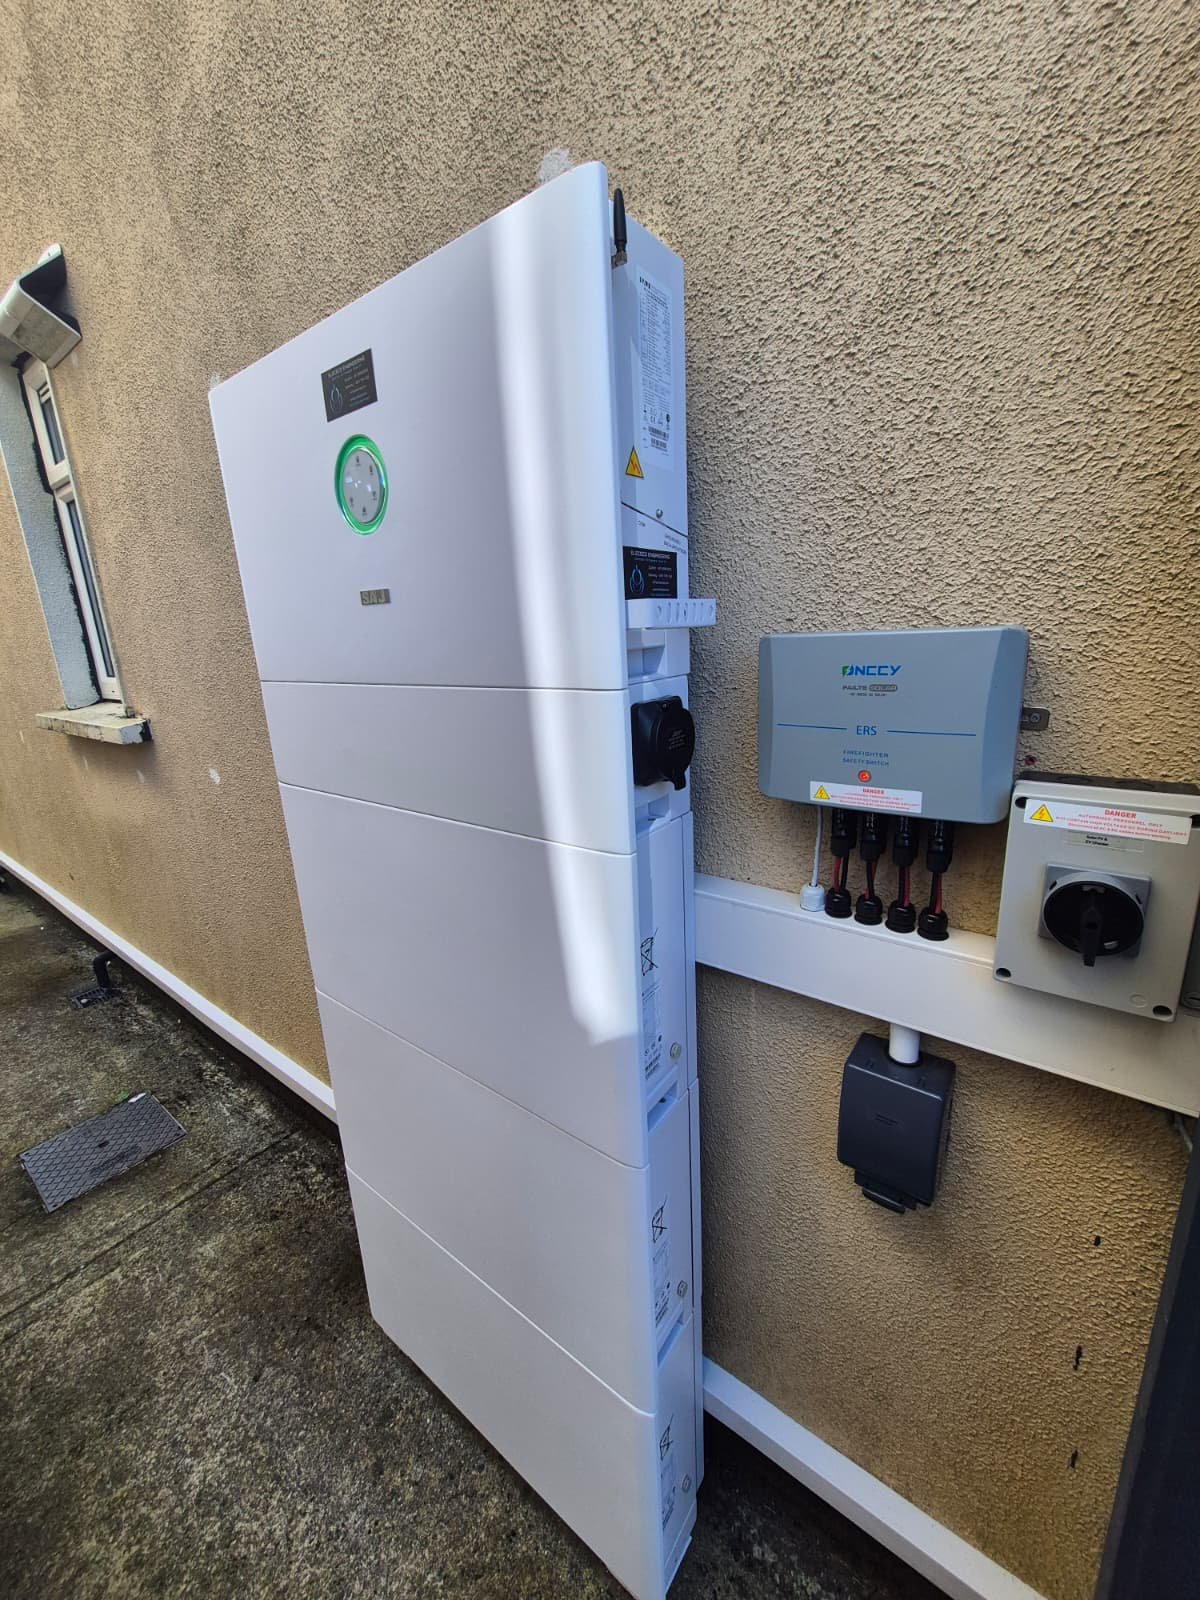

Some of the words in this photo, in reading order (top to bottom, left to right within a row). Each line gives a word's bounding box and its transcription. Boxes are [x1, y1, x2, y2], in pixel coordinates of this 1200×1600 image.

[361, 590, 386, 604] SAJ
[856, 725, 877, 736] ERS
[843, 750, 889, 758] FIREFIGHTER
[1104, 809, 1137, 818] DANGER
